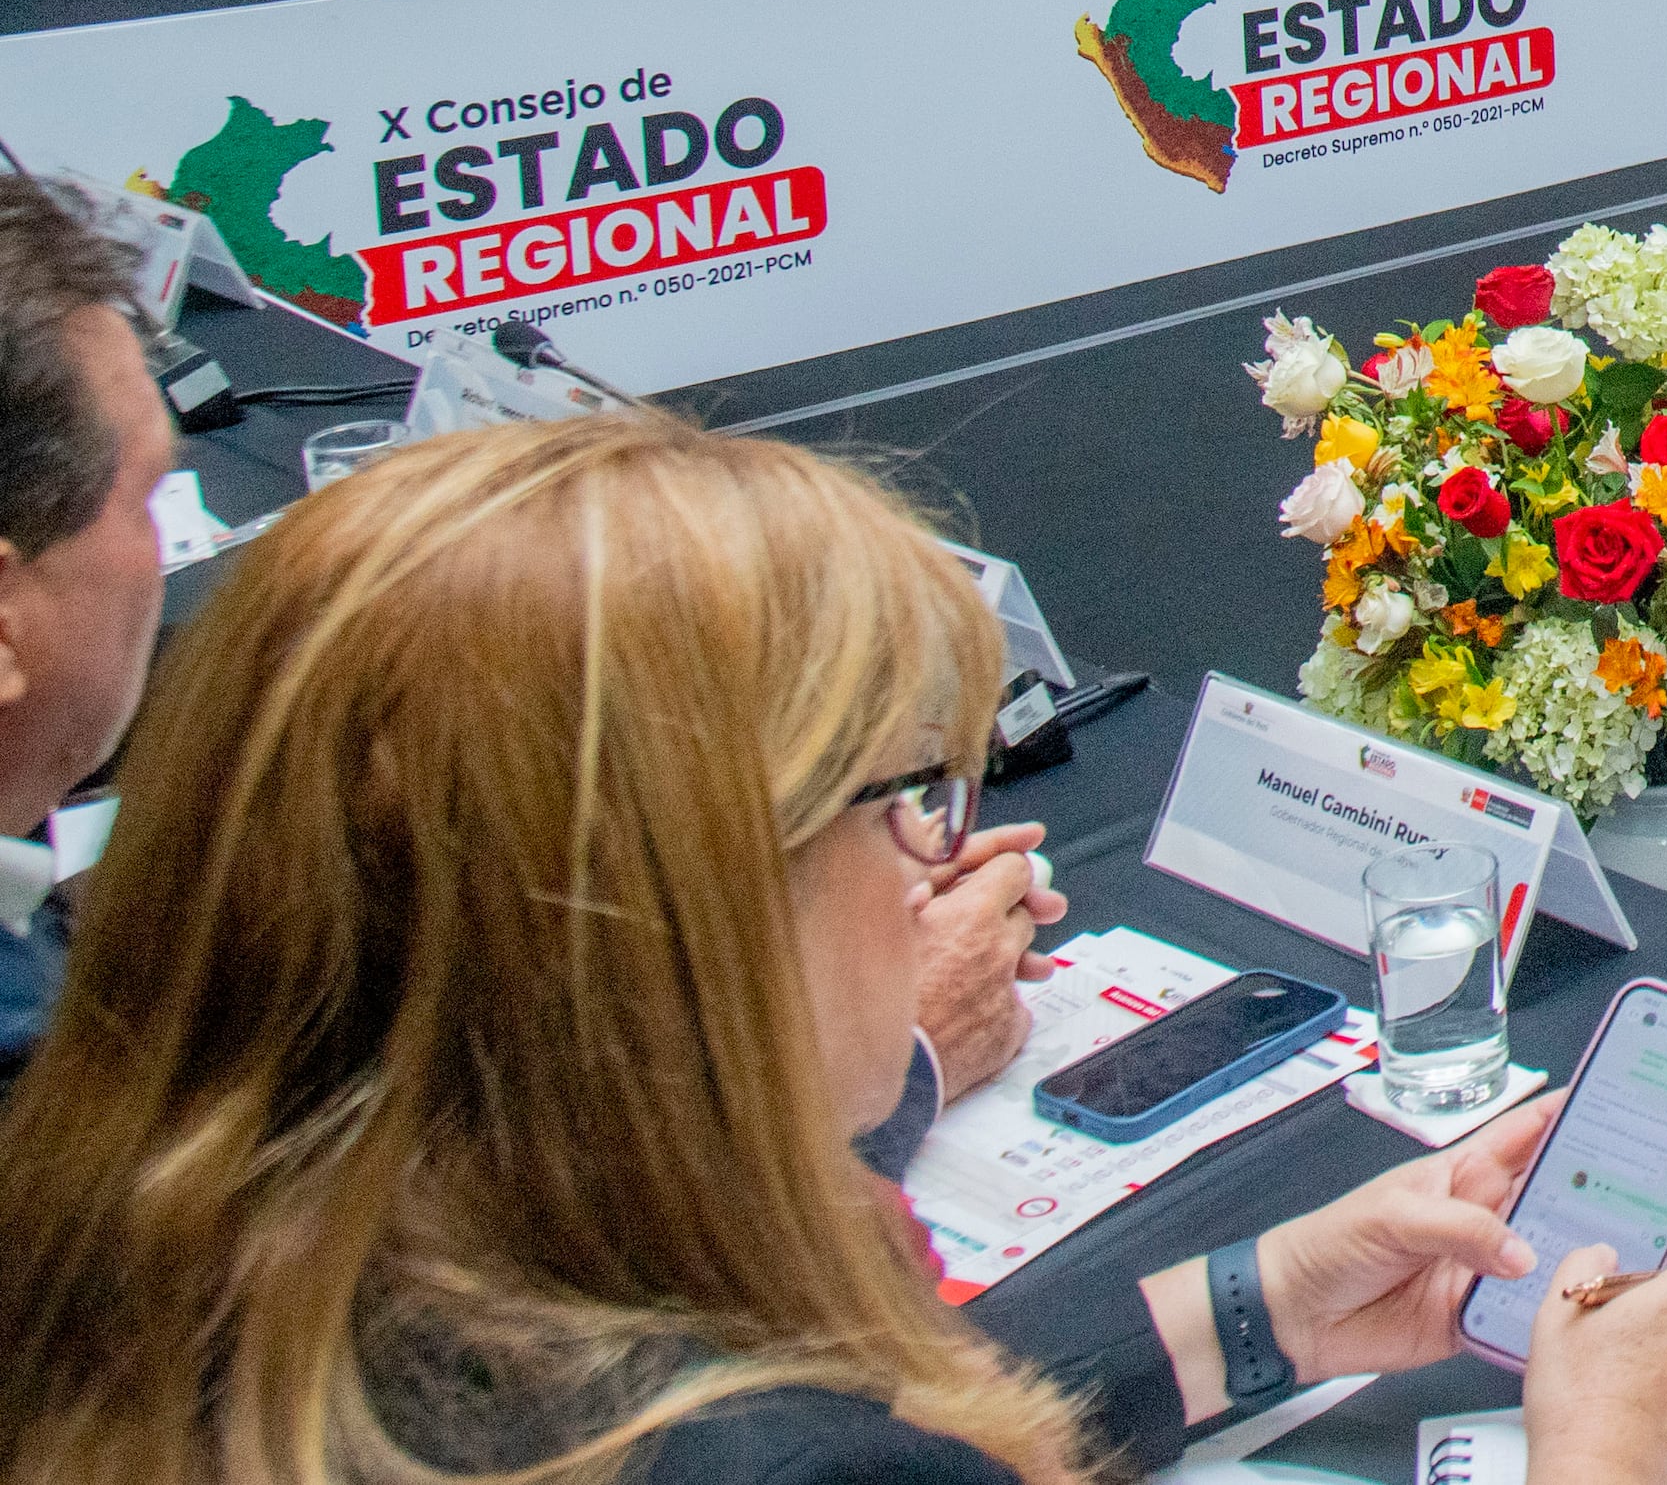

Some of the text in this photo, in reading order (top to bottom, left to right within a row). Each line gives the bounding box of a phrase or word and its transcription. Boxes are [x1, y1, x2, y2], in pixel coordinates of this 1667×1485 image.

[379, 67, 673, 144] X Consejo de
[1261, 36, 1544, 138] REGIONAL
[372, 96, 785, 236] ESTADO
[1262, 96, 1545, 170] Decreto Supremo 050-2021-PCM
[402, 185, 810, 310] REGIONAL
[408, 248, 813, 349] Dereto Supremo 050-2021-PCM
[1256, 767, 1393, 838] Manuel Gambini
[1269, 804, 1326, 837] Gobernador
[1325, 824, 1369, 854] Regional
